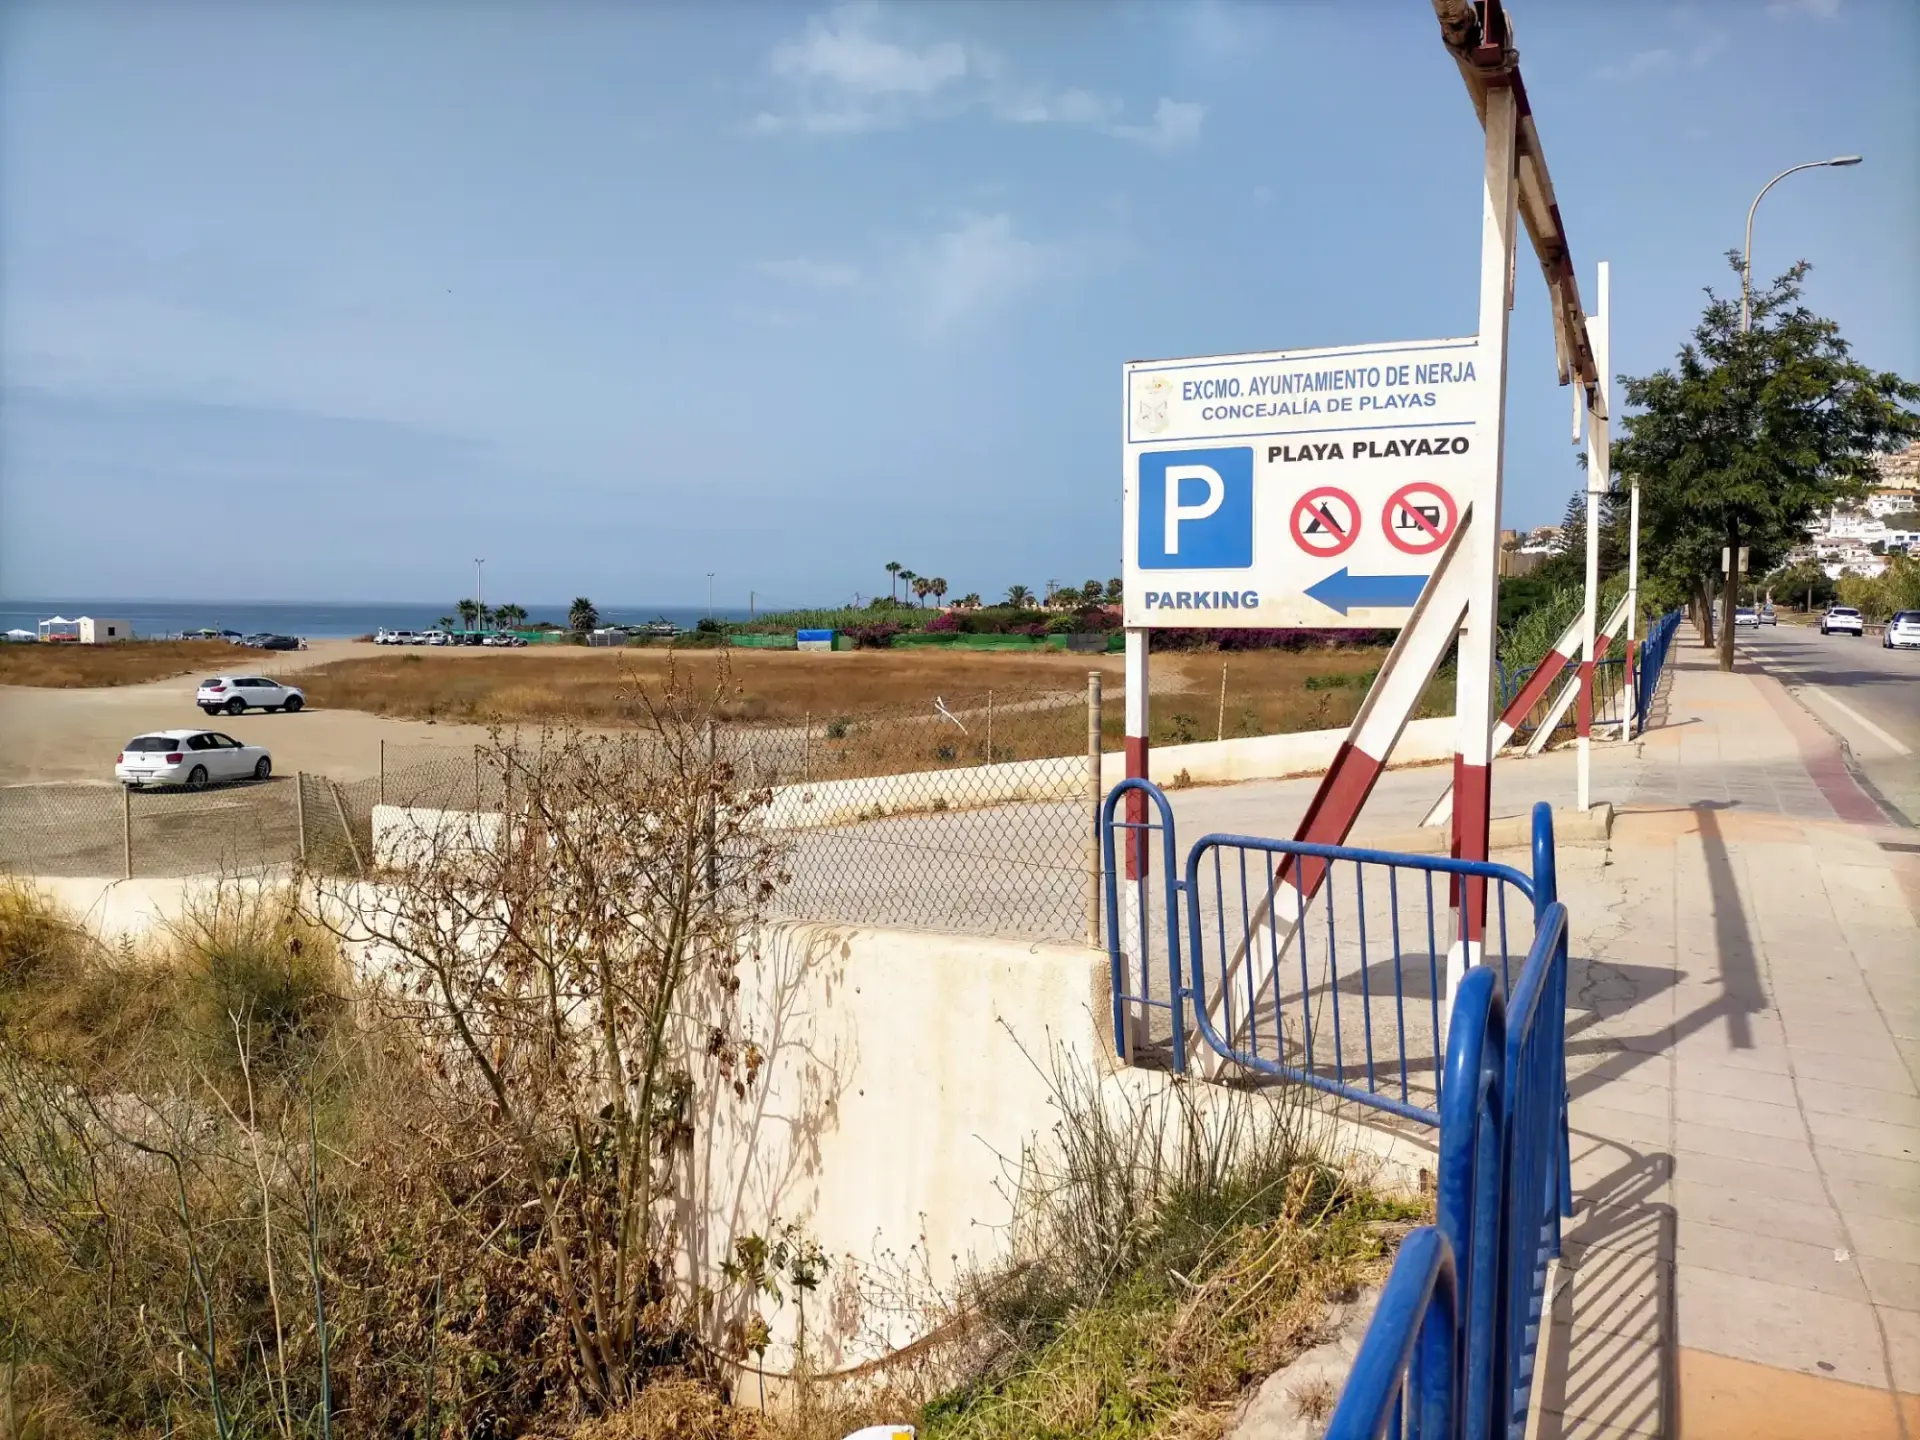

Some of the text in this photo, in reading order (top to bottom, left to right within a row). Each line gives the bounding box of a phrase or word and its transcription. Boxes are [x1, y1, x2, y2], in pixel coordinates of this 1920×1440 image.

[1182, 361, 1477, 401] EXCMO. AYUNTAMIENTO DE NERJA
[1201, 392, 1437, 421] CONCEJALÍA DE PLAYAS
[1267, 436, 1470, 463] PLAYA PLAYAZO
[1164, 464, 1225, 555] P
[1144, 590, 1260, 610] PARKING
